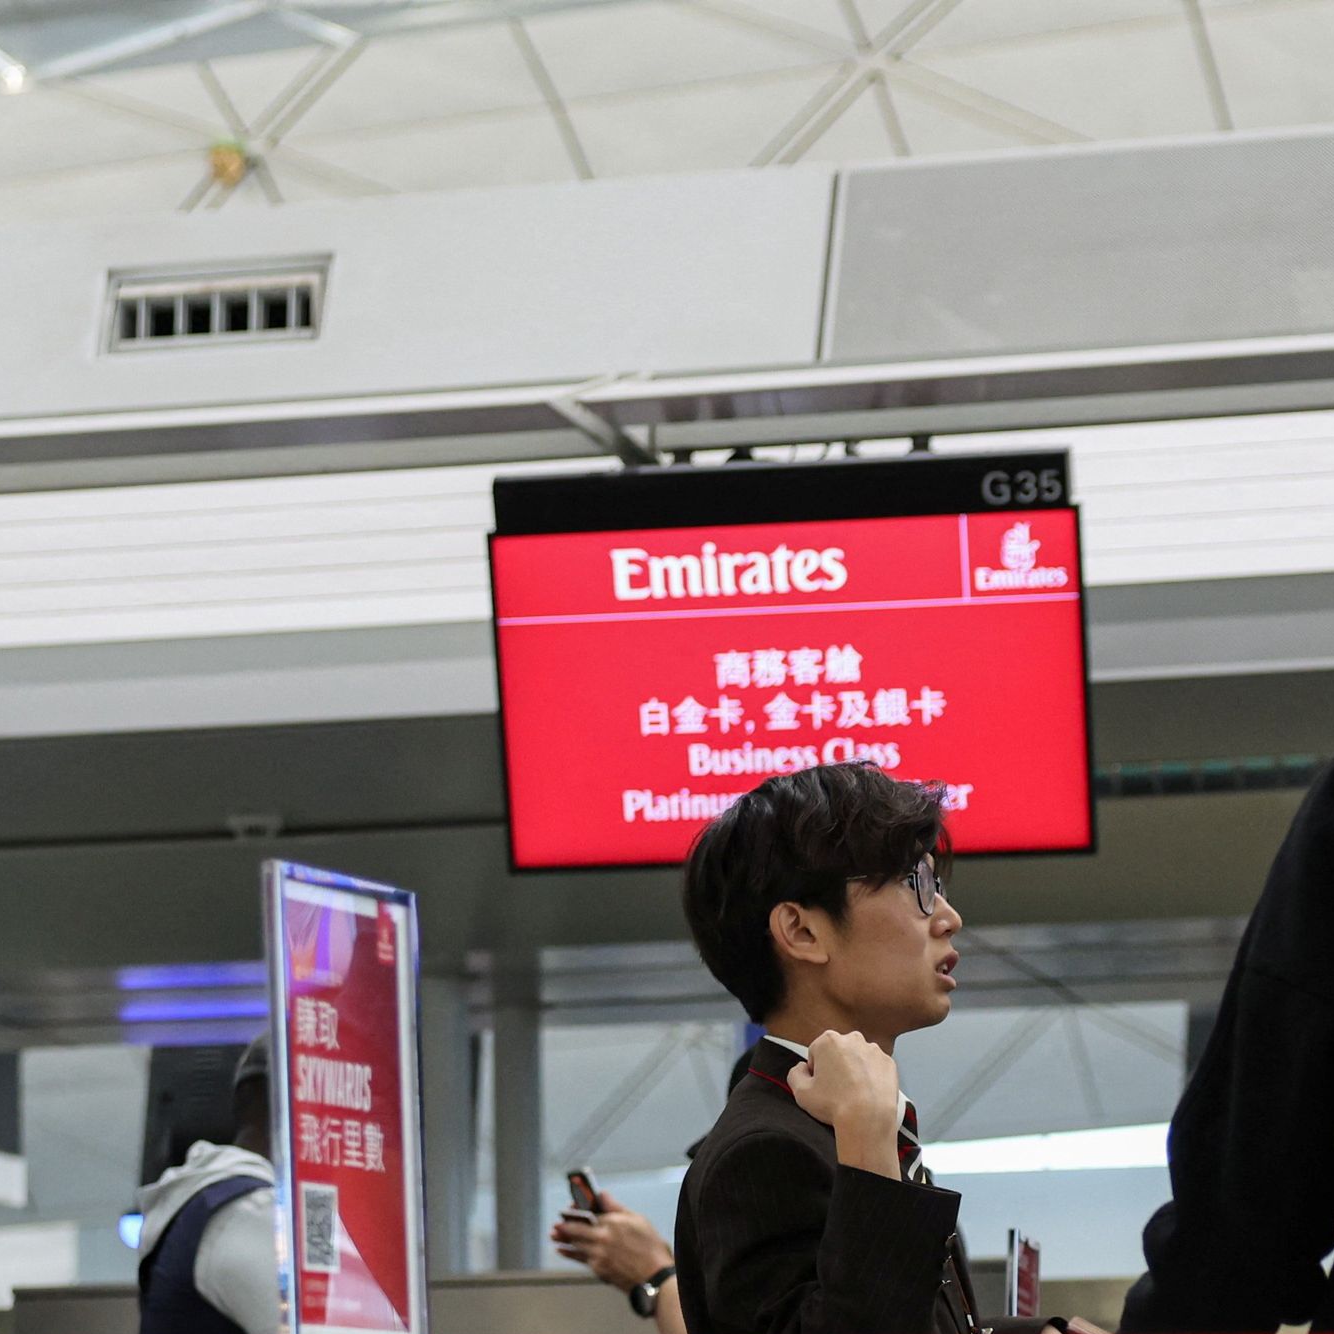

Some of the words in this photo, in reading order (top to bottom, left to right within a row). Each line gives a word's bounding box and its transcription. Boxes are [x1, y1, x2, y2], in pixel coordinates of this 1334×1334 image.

[981, 469, 1063, 505] G35
[609, 541, 849, 601] Emirates
[714, 644, 864, 689] 商務客艙
[687, 740, 818, 777] Business
[622, 787, 747, 822] Platinu
[296, 1055, 373, 1112] SKYWARDS
[299, 1113, 386, 1173] 飛行里數
